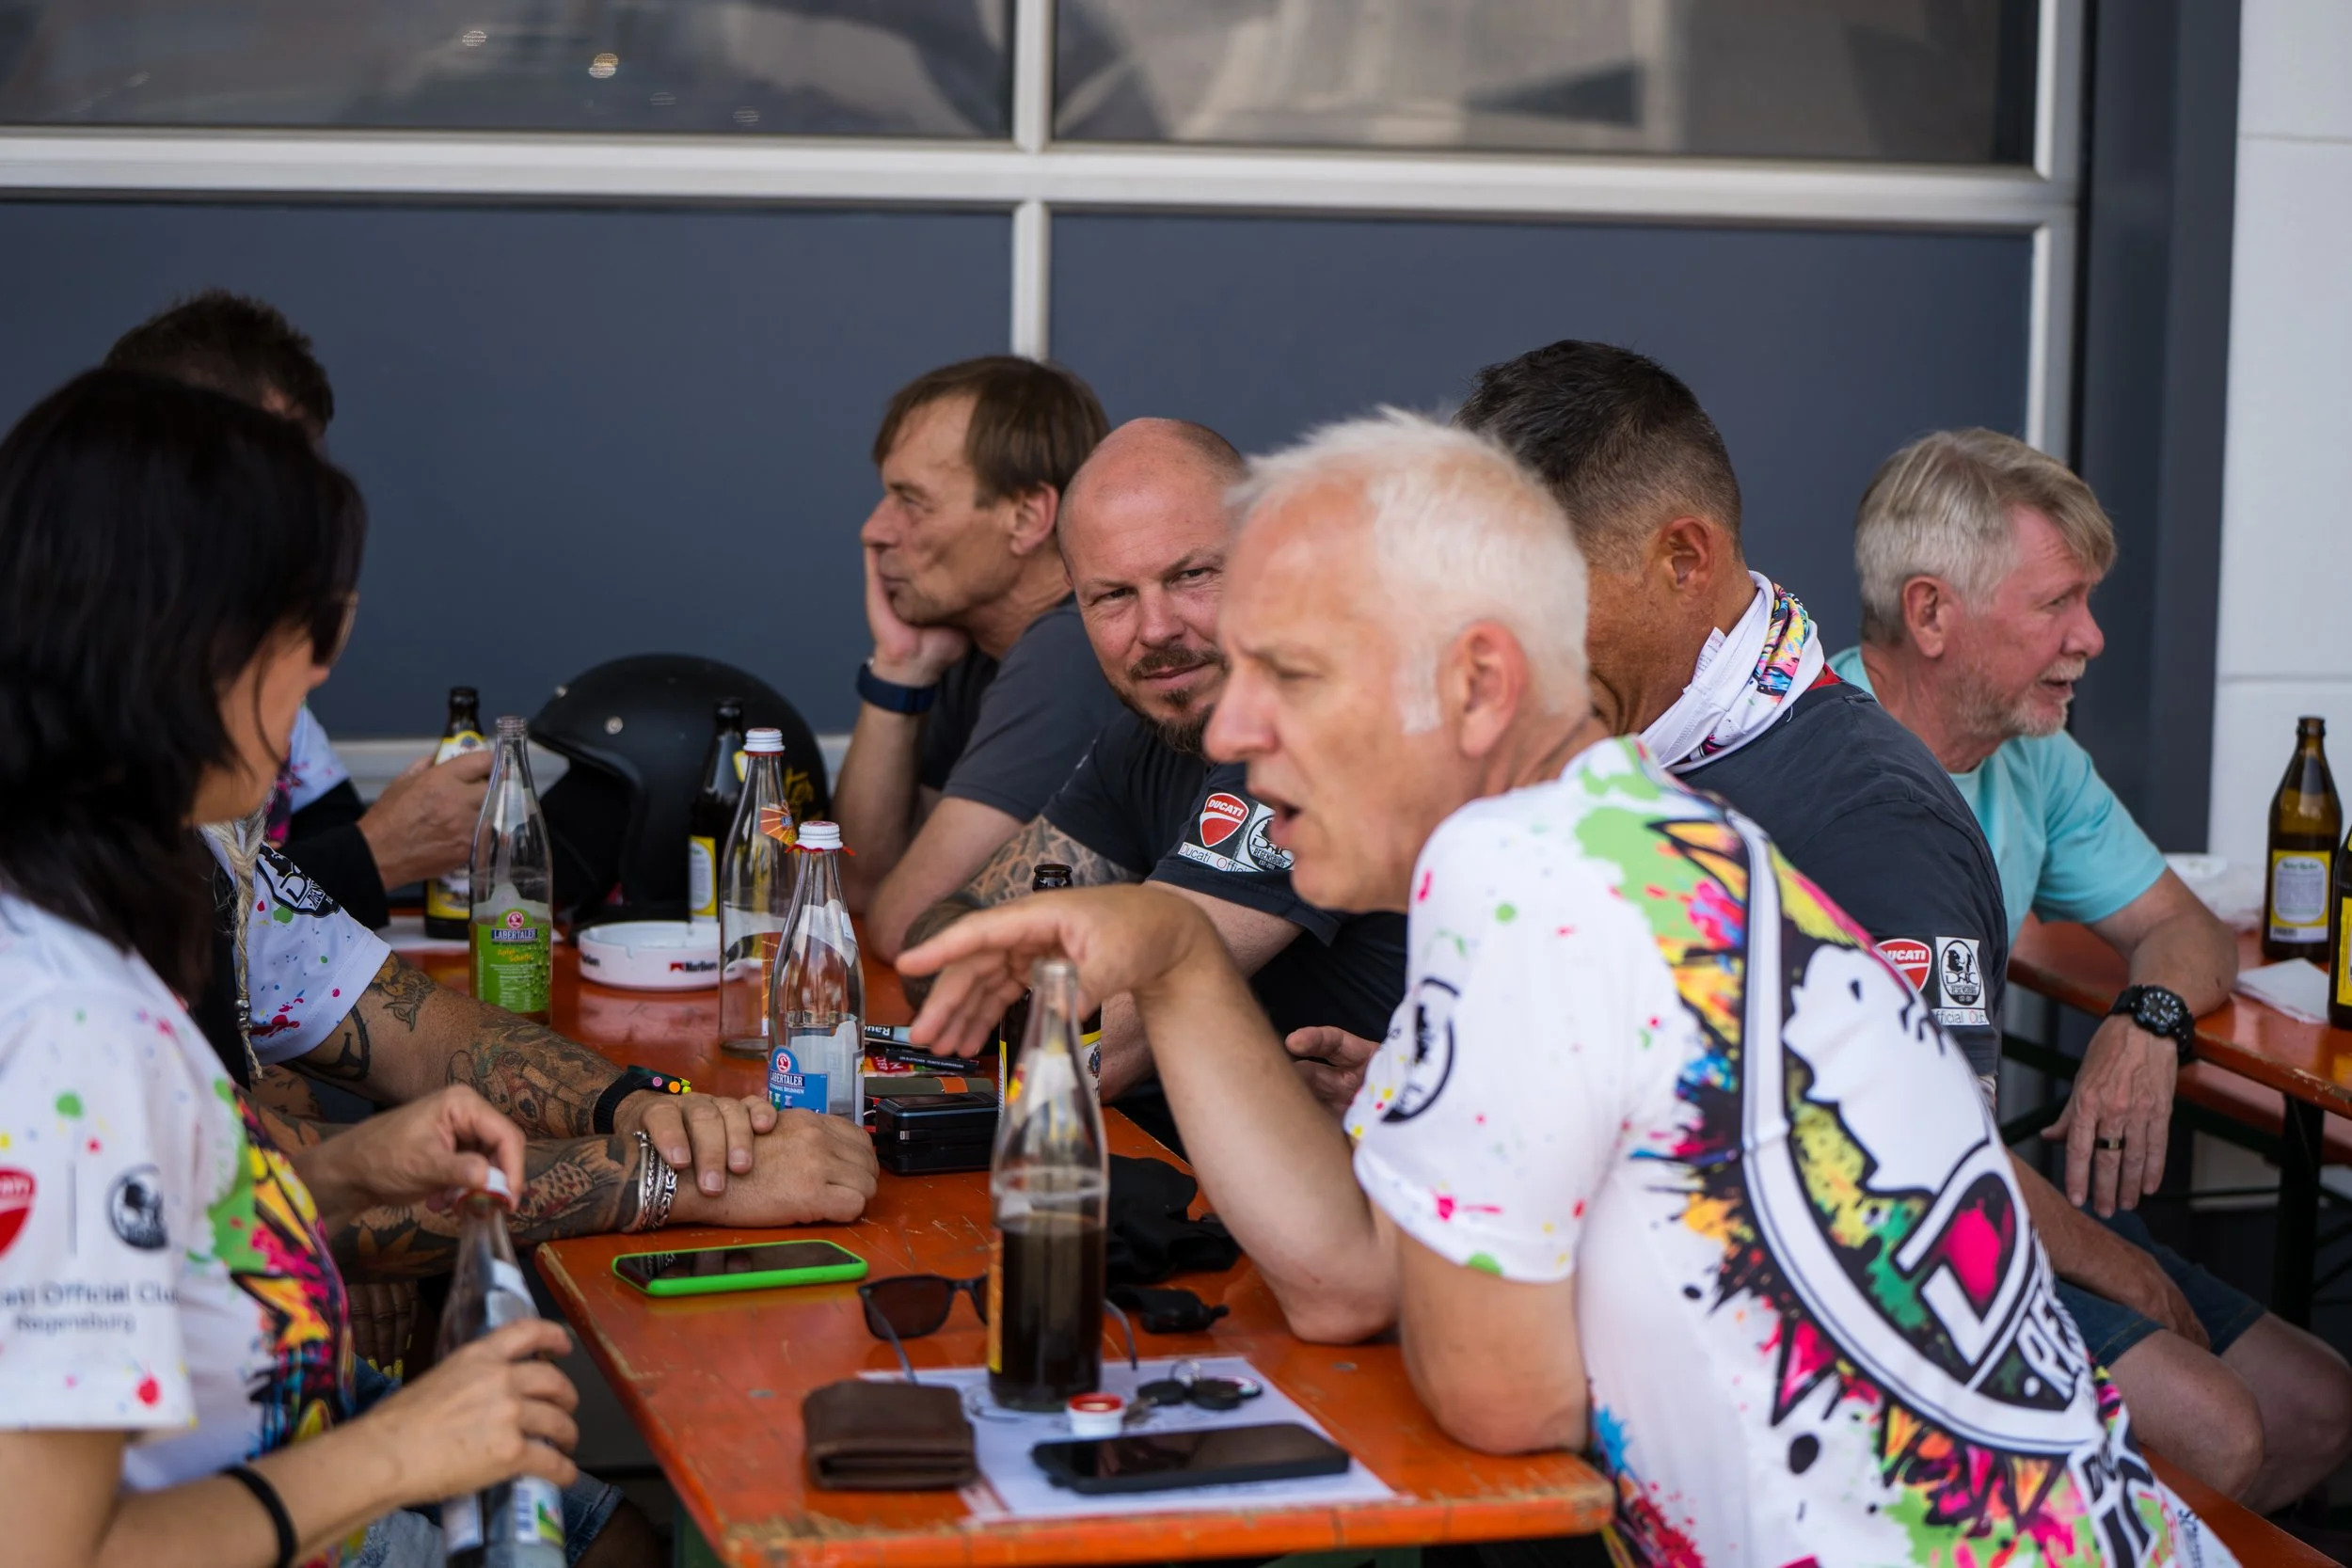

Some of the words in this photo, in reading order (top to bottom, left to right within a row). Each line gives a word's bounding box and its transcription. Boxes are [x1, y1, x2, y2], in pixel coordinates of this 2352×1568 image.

[1208, 799, 1245, 817] DUCATI
[1179, 843, 1212, 863] Ducati
[1253, 847, 1286, 866] REGENSBURG
[494, 928, 536, 940] LABERTALER
[1934, 1009, 1964, 1024] fficial
[771, 1071, 803, 1086] LABERTALER
[2, 1287, 35, 1307] ati
[43, 1281, 130, 1307] Official
[138, 1282, 179, 1306] Clu
